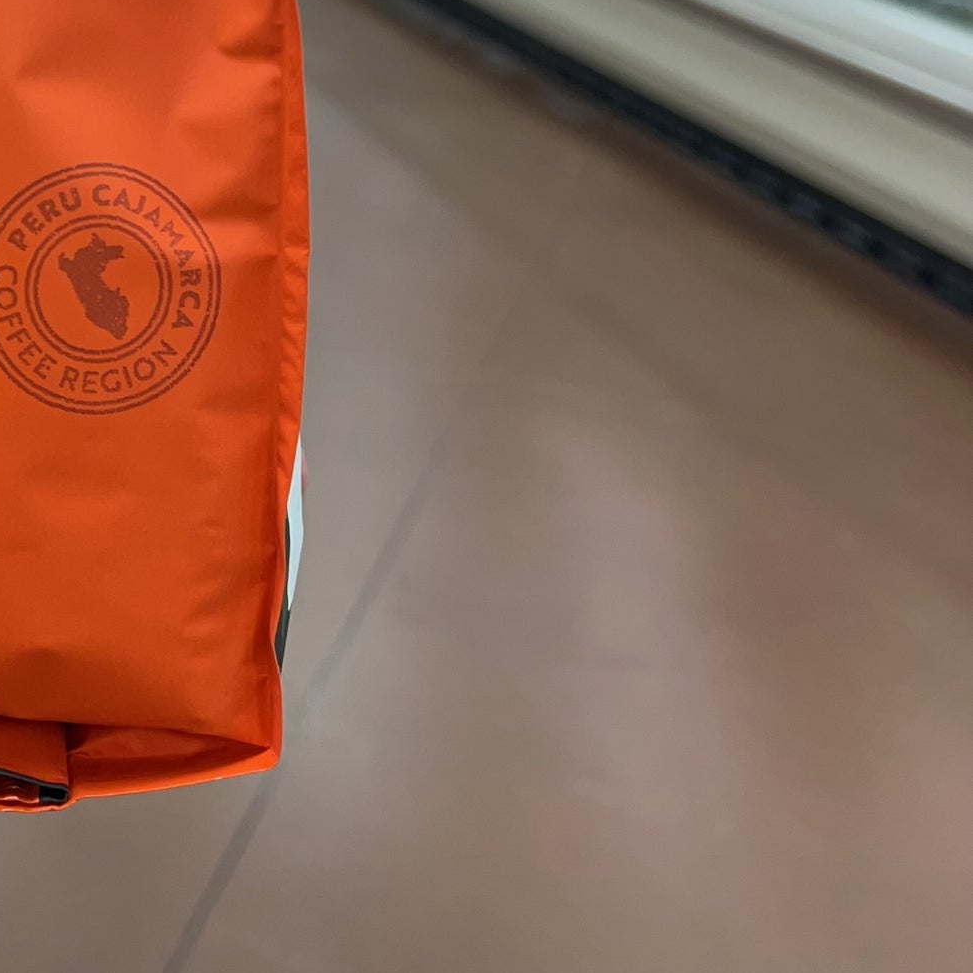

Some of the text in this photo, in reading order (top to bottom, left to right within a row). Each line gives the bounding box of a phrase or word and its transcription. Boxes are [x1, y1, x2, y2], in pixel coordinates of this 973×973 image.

[8, 184, 202, 329] PERU CAJAMARCA
[59, 339, 177, 394] REGION
